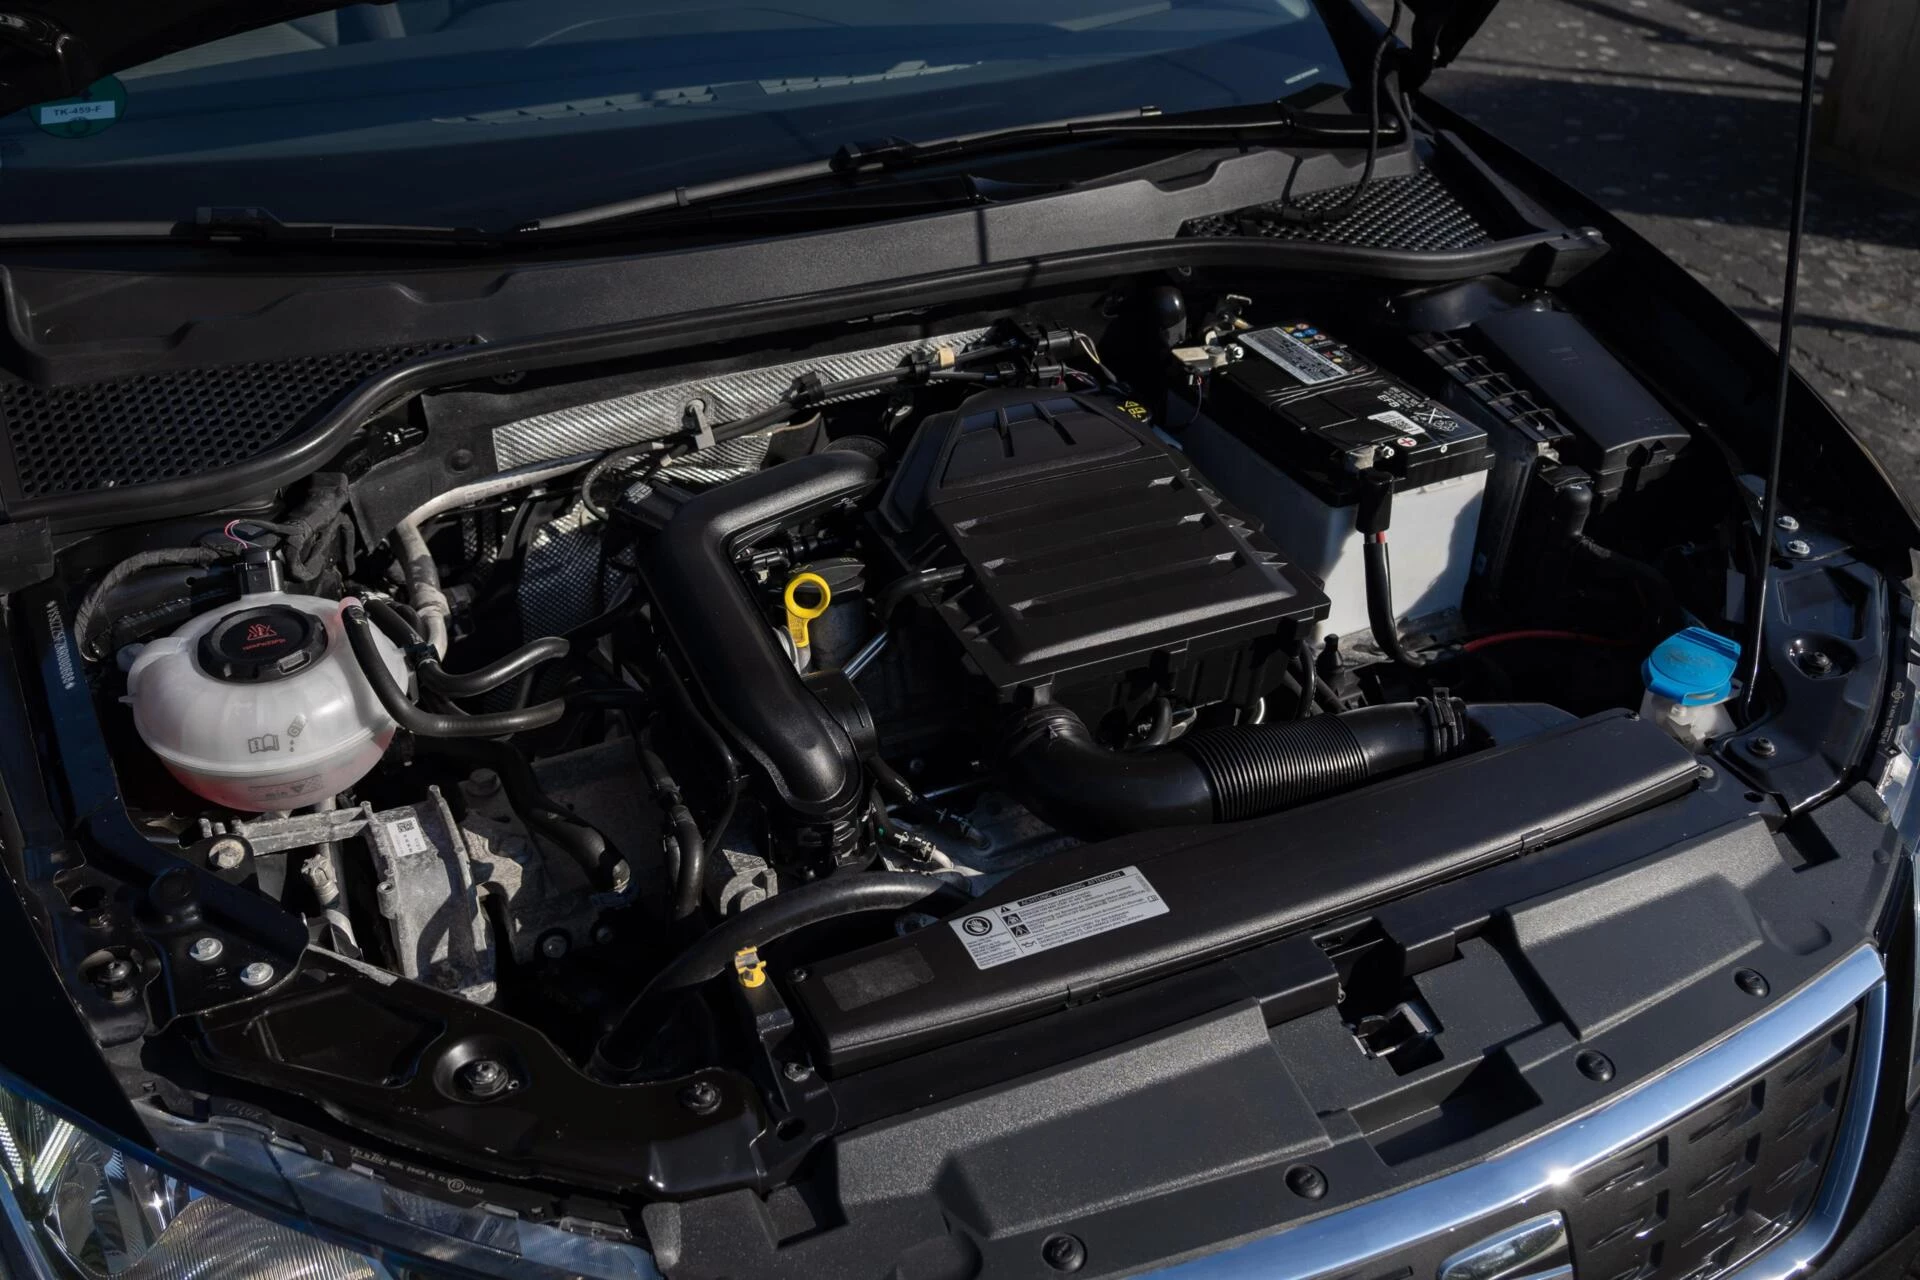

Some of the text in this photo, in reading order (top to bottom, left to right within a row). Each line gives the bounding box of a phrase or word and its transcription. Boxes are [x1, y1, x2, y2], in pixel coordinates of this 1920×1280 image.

[53, 105, 102, 116] TK-459-F
[1020, 891, 1051, 906] ACHTUNG
[1056, 881, 1084, 896] WARNING
[1088, 871, 1121, 887] ATTENTION
